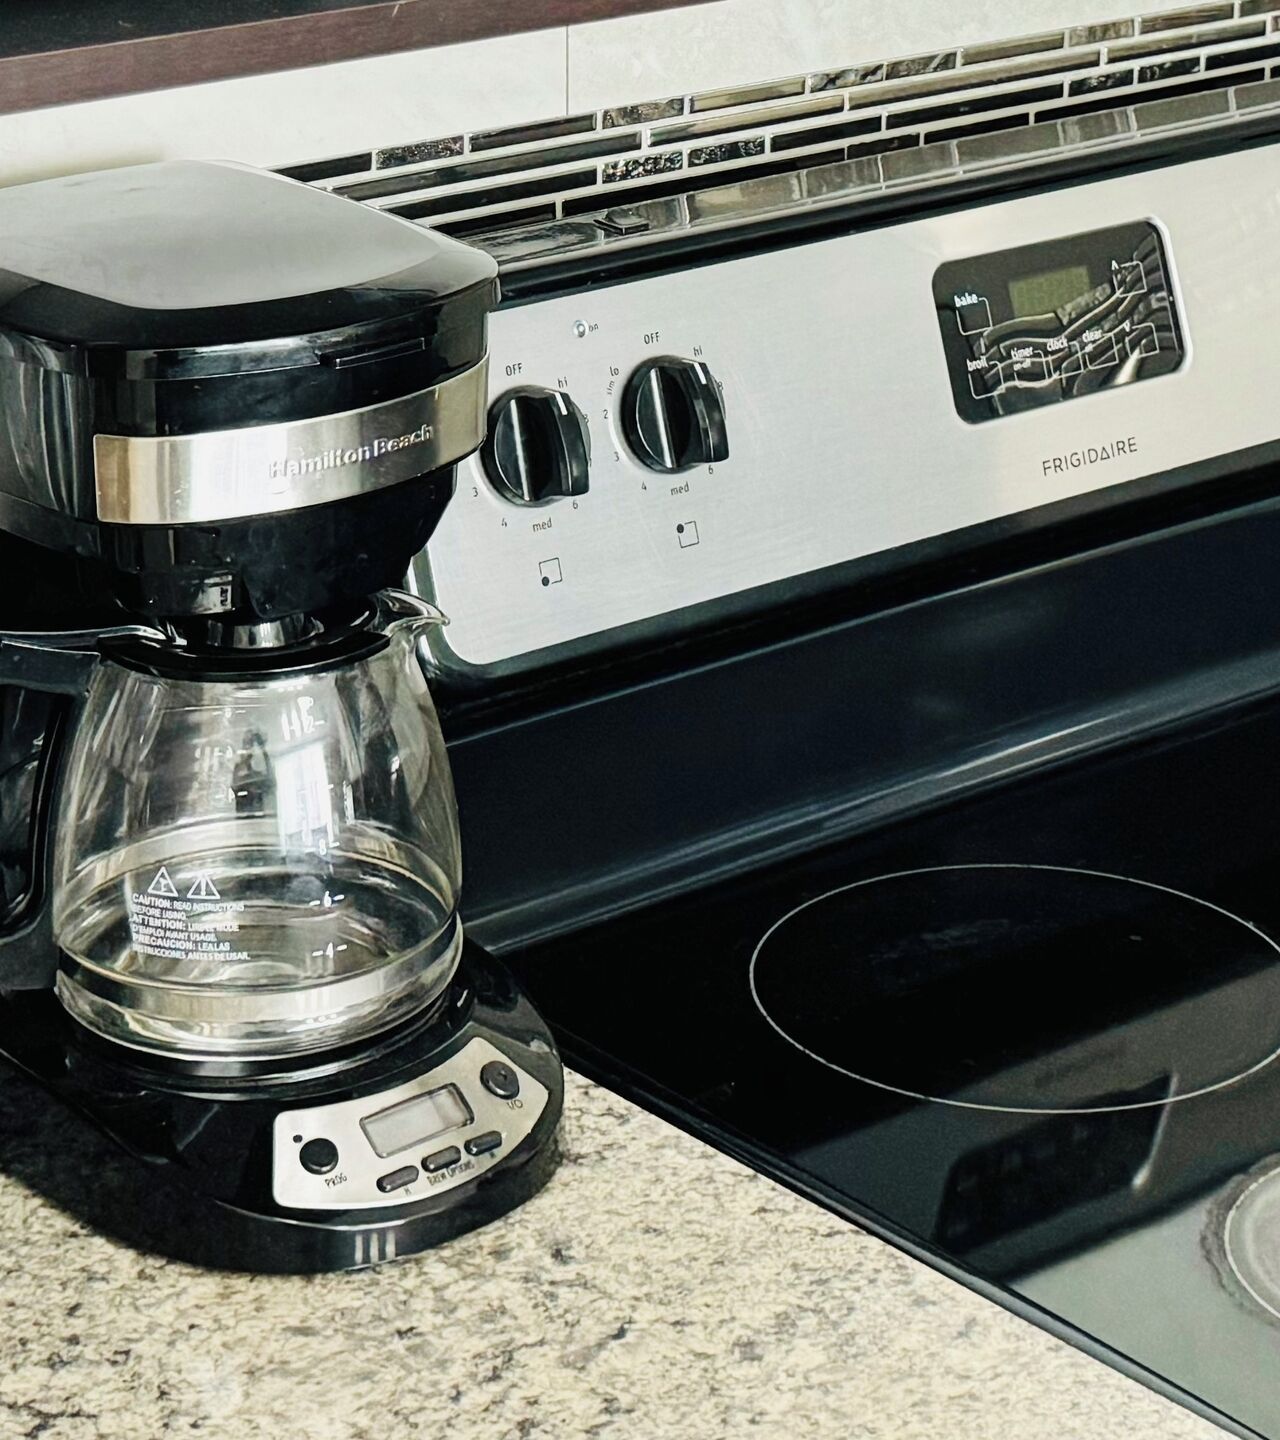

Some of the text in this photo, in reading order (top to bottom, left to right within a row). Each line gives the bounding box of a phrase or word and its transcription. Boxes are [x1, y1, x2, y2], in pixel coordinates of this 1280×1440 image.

[954, 291, 979, 308] bake
[588, 323, 600, 333] on
[643, 331, 661, 345] OFF
[1046, 334, 1068, 351] clock
[1082, 328, 1103, 343] clear
[693, 345, 704, 357] hi
[1011, 346, 1033, 360] timer
[505, 362, 524, 377] OFF
[966, 355, 988, 372] broil
[609, 365, 620, 377] lo
[557, 376, 569, 389] hi
[603, 409, 609, 420] 2
[267, 423, 435, 480] Hamilton Beach
[614, 451, 620, 462] 3
[1041, 436, 1138, 477] FRIGIDAIRE
[708, 464, 714, 475] 6
[472, 487, 479, 498] 3
[641, 481, 648, 492] 4
[670, 481, 690, 496] med
[572, 498, 579, 511] 6
[501, 517, 508, 528] 4
[532, 517, 553, 533] med
[132, 893, 172, 909] CAUTION:
[324, 890, 332, 907] 6
[131, 904, 162, 917] BEFORE
[131, 914, 186, 930] ATTENTION:
[131, 933, 196, 950] PRECAUCION:
[325, 942, 334, 959] 4
